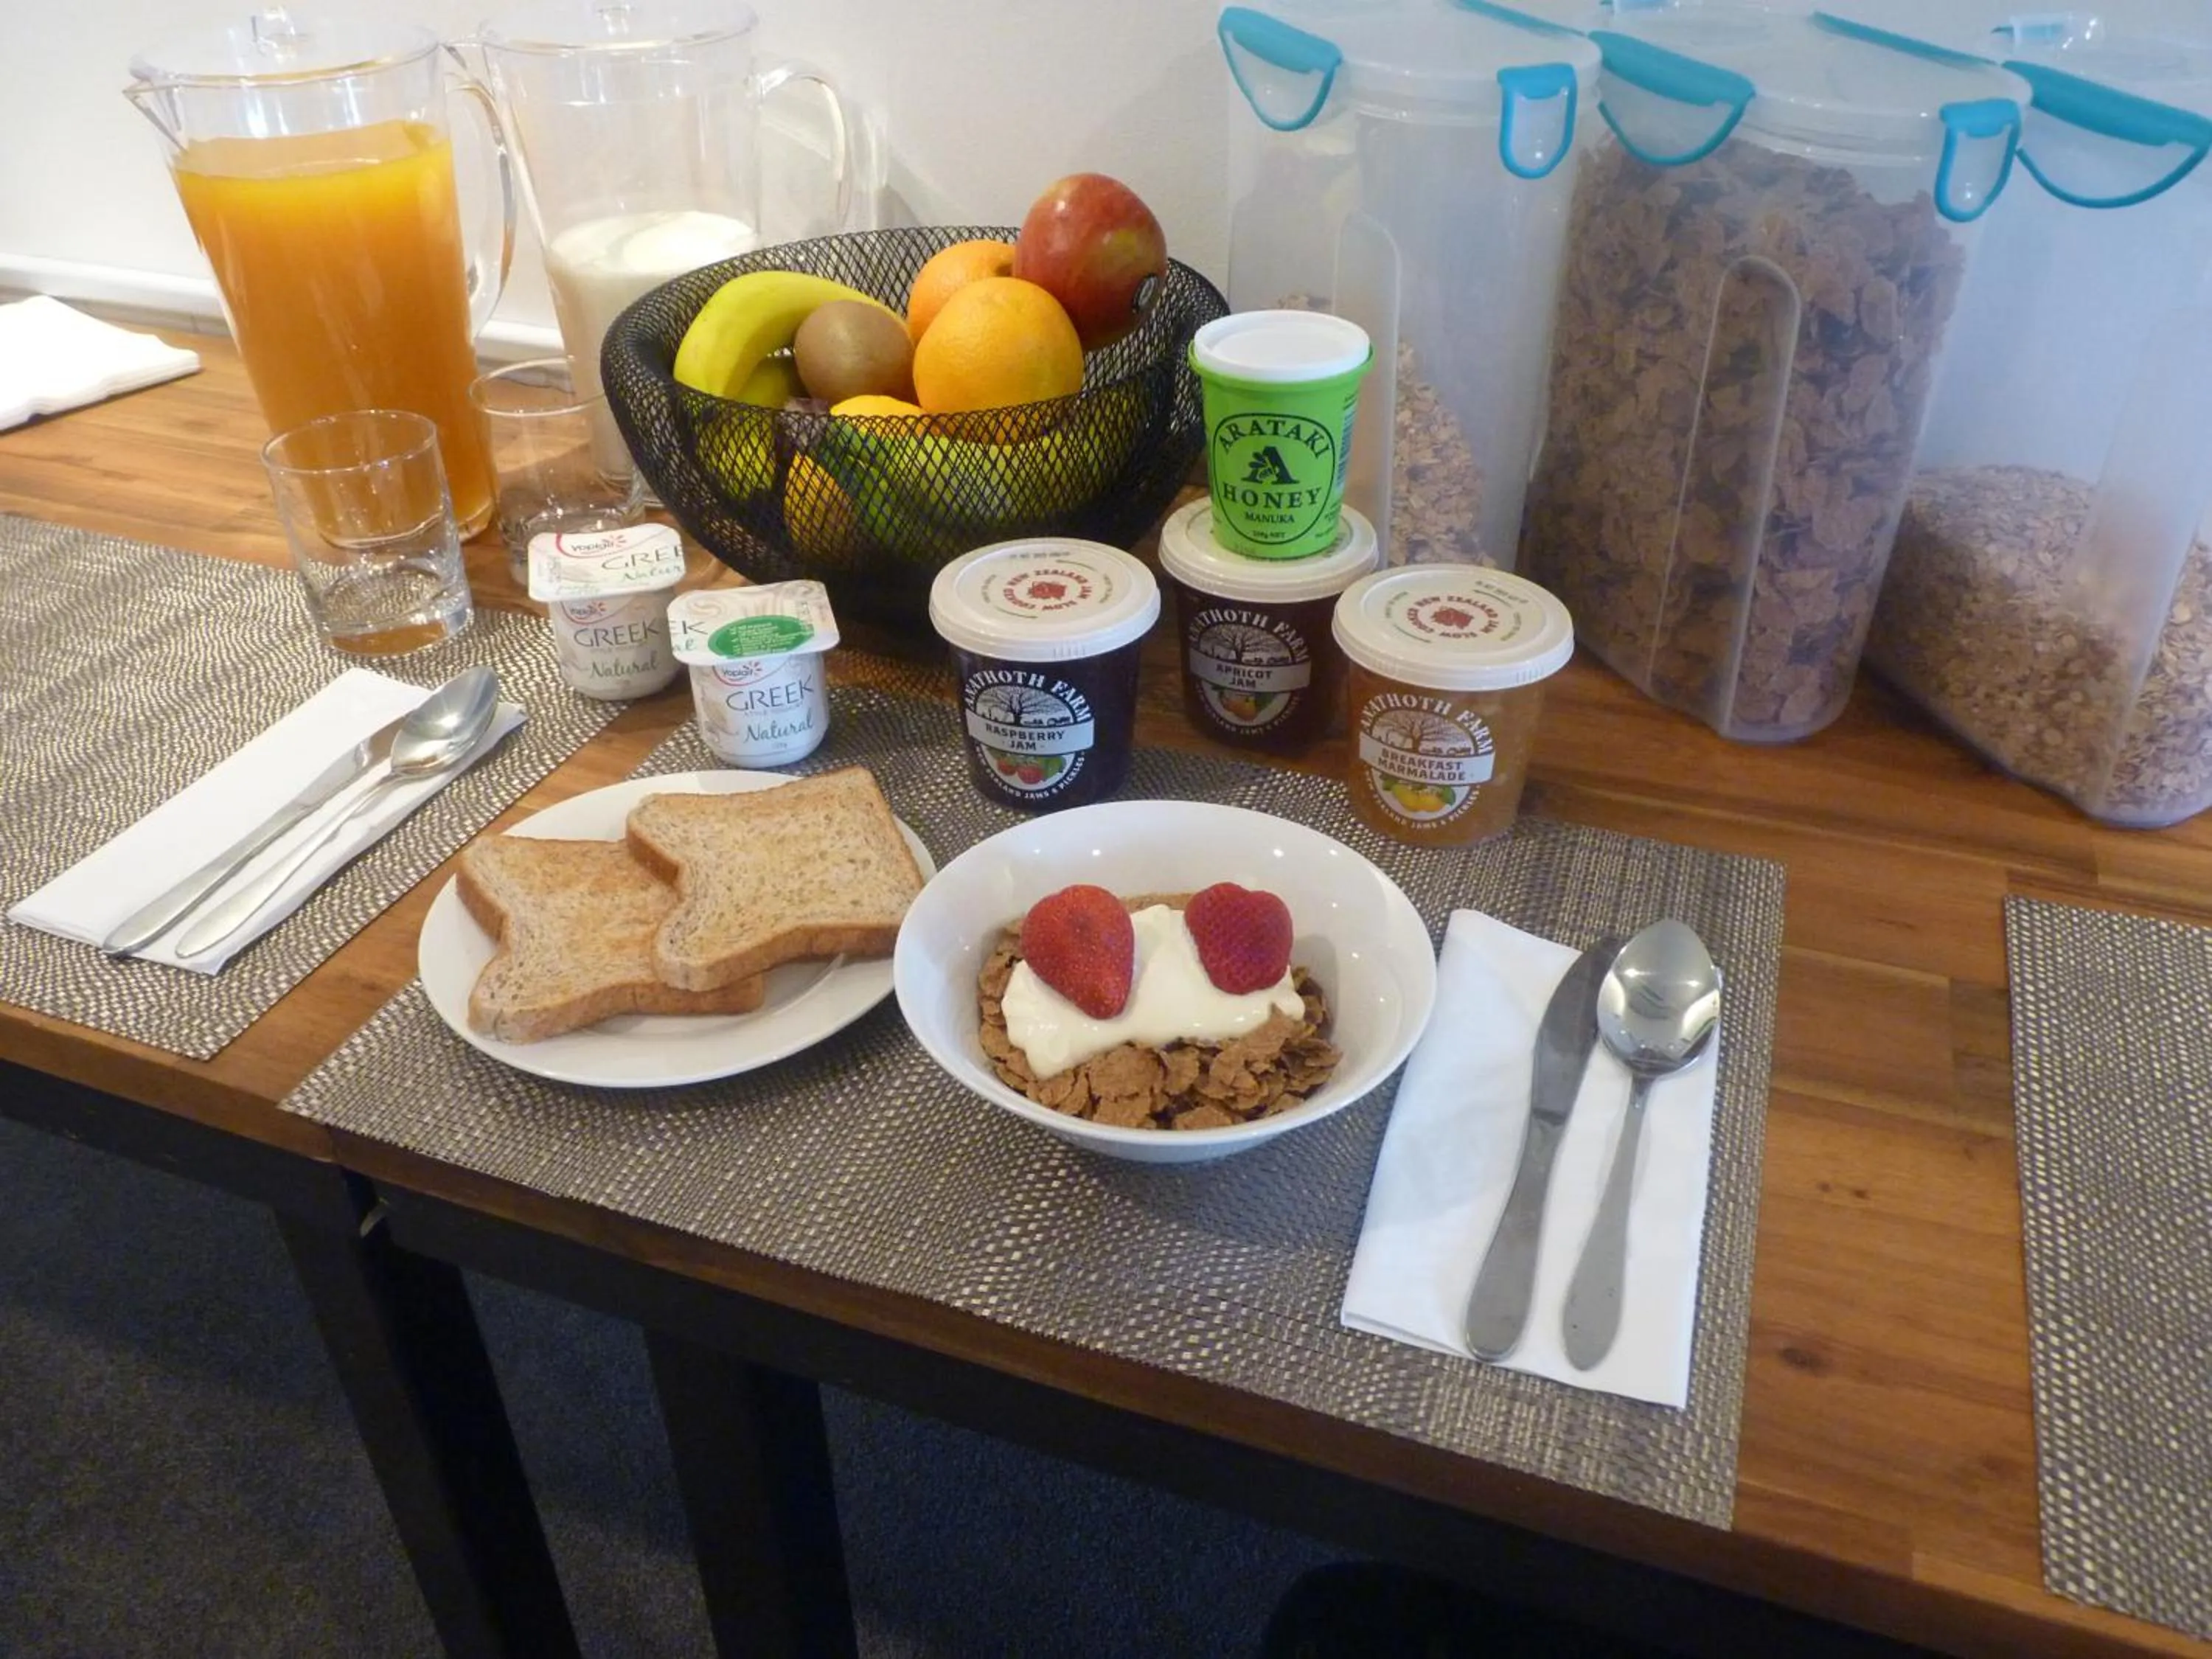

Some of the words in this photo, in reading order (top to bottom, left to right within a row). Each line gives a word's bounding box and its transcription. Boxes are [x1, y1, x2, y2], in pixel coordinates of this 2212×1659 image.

[1219, 420, 1330, 459] ARATAKI
[1222, 481, 1322, 509] HONEY
[1244, 511, 1295, 524] MANUKA
[574, 617, 660, 647] GREEK
[590, 650, 658, 678] Natural
[1216, 664, 1273, 680] APRICOT
[726, 674, 814, 711] GREEK
[1229, 678, 1256, 688] JAM
[1051, 680, 1091, 722] FARM
[743, 708, 813, 743] Natural
[985, 723, 1065, 741] RASPBERRY
[1455, 709, 1494, 753] FARM
[1009, 740, 1037, 751] JAM
[1381, 748, 1463, 771] BREAKFAST
[1377, 757, 1467, 781] MARMALADE
